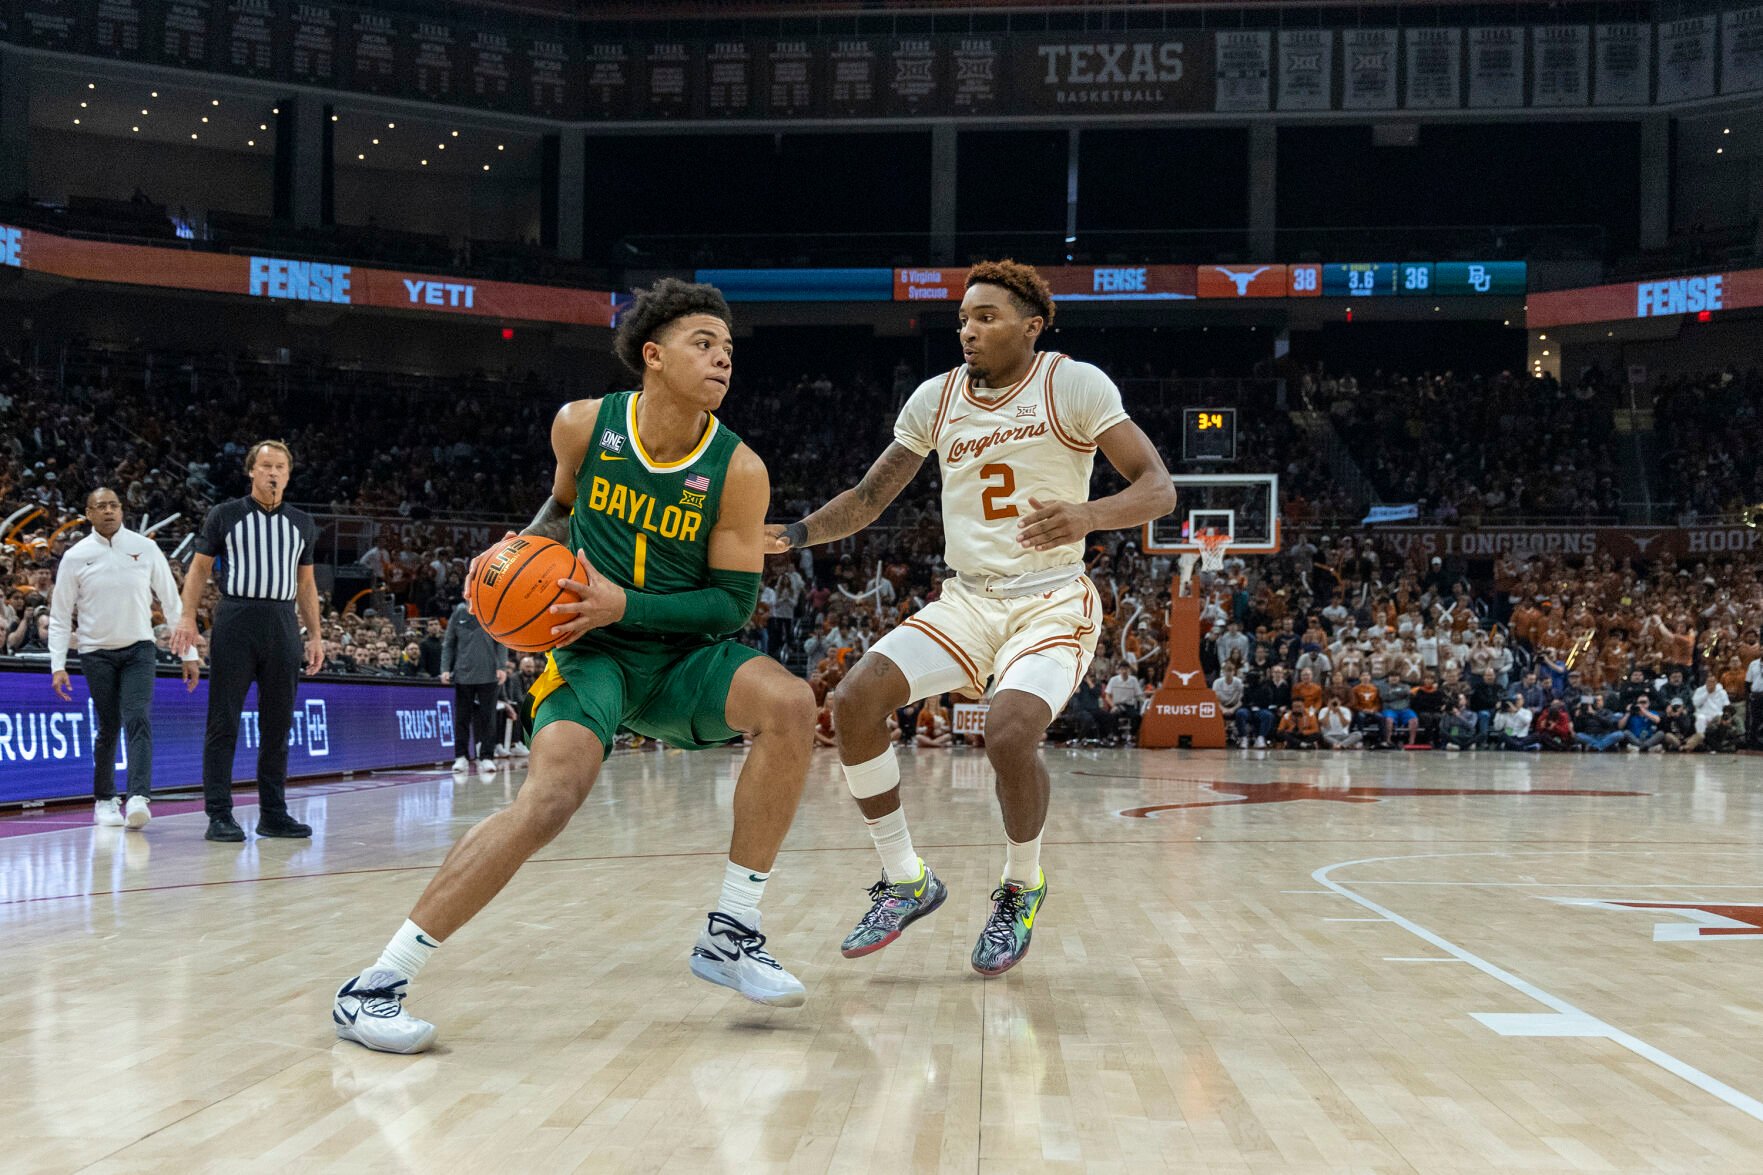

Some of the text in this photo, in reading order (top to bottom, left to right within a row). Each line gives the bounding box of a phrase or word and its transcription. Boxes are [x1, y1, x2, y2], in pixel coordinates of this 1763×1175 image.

[1038, 42, 1184, 84] TEXAS
[1056, 90, 1164, 103] BASKETBALL
[249, 256, 350, 304] FENSE
[909, 270, 942, 284] Virginia
[1093, 268, 1147, 292] FENSE
[1293, 268, 1316, 291] 38
[1405, 267, 1428, 289] 36
[403, 280, 474, 308] YETI
[908, 286, 949, 299] Syracuse
[1637, 275, 1723, 317] FENSE
[1198, 412, 1223, 430] 3.4
[603, 430, 625, 448] ONE
[947, 421, 1049, 463] Longhorns
[980, 463, 1019, 520] 2
[589, 476, 702, 542] BAYLOR
[633, 532, 647, 588] 1
[1156, 705, 1198, 715] TRUIST
[0, 712, 84, 761] RUIST
[396, 710, 437, 740] TRUIST
